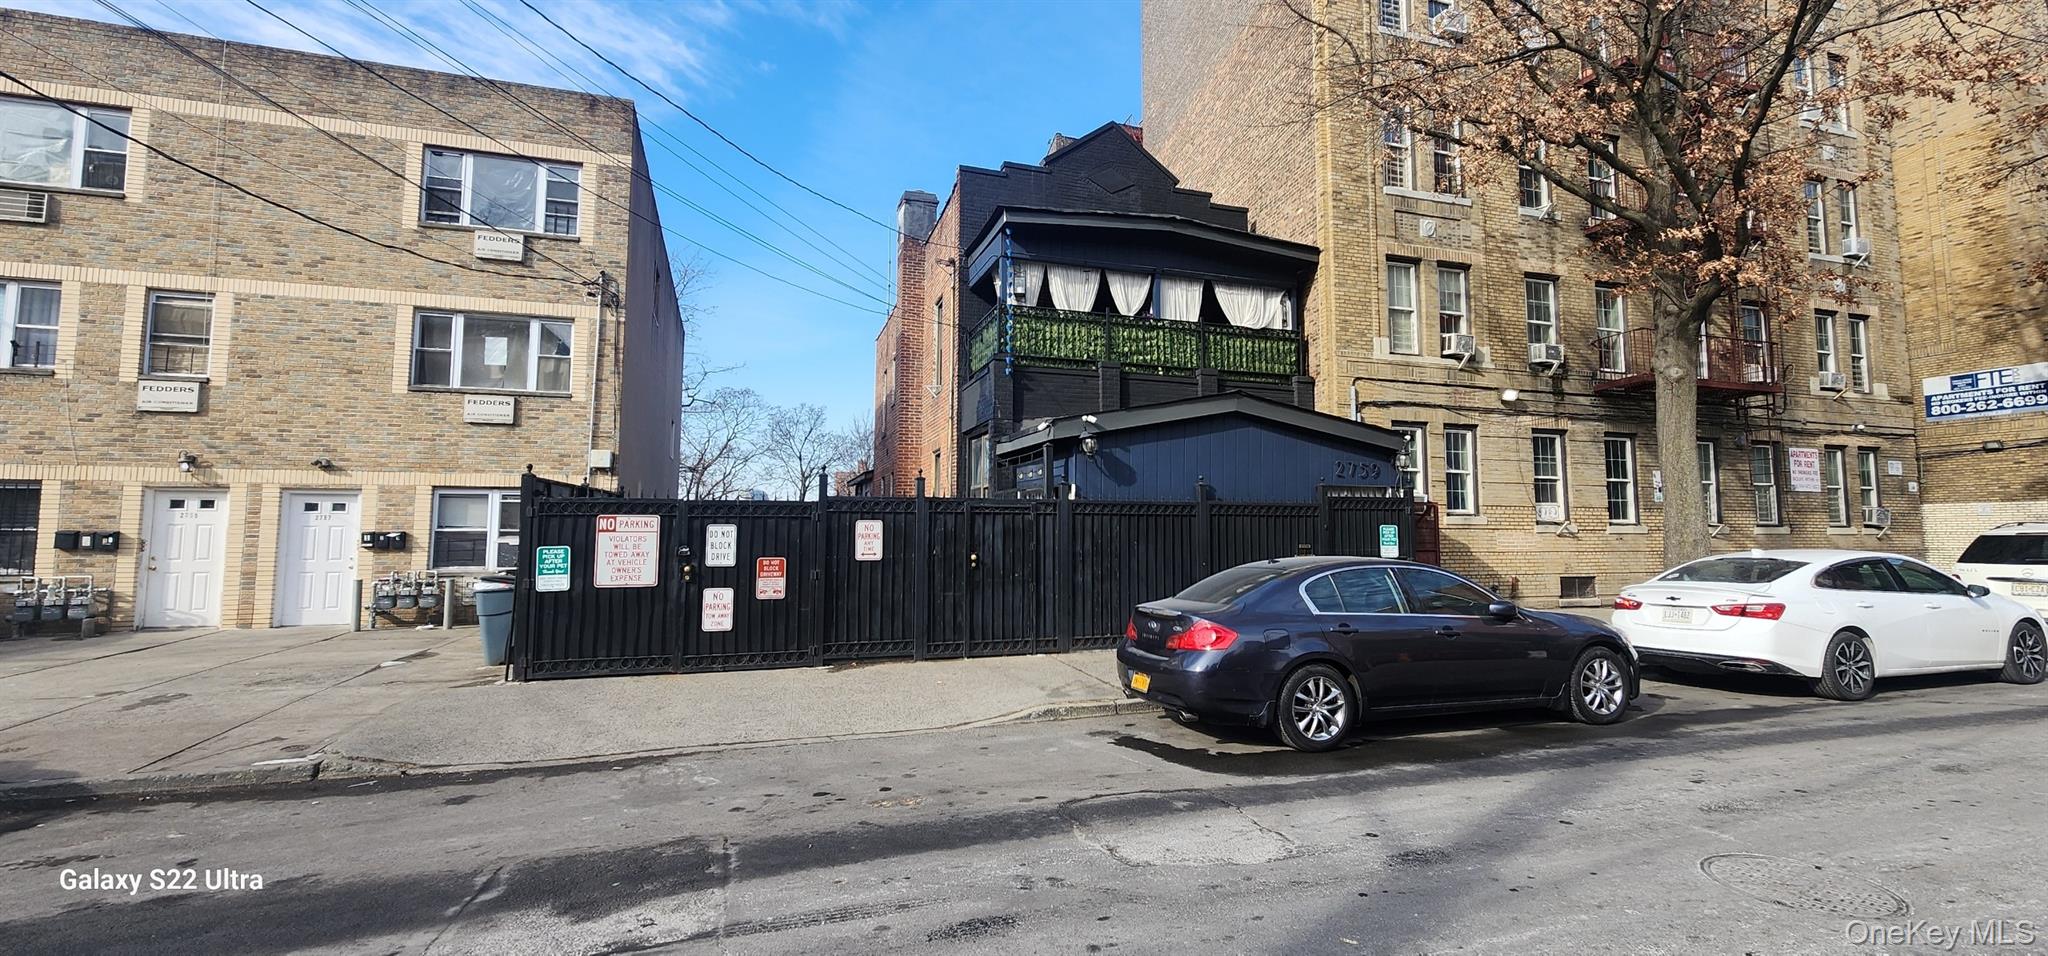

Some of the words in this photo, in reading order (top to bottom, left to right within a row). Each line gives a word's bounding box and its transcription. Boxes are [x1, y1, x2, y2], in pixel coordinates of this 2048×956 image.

[142, 385, 195, 393] FEDDERS
[1931, 388, 1994, 402] APARTMENTS
[1995, 385, 2016, 395] FOR
[2018, 382, 2046, 392] RENT
[467, 399, 512, 407] FEDDERS
[1931, 393, 2048, 416] 800-262-6699
[1790, 450, 1818, 459] APARTMENTS
[1793, 460, 1803, 468] FOR
[1804, 460, 1815, 469] RENT
[1334, 460, 1381, 480] 2759
[600, 518, 615, 531] NO
[619, 520, 655, 529] PARKING
[864, 524, 875, 532] NO
[709, 530, 718, 538] DO
[721, 530, 734, 538] NOT
[858, 532, 881, 540] PARKING
[608, 535, 648, 543] VIOLATORS
[710, 541, 732, 550] BLOCK
[711, 553, 731, 561] DRIVE
[712, 592, 724, 601] NO
[705, 602, 731, 610] PARKING
